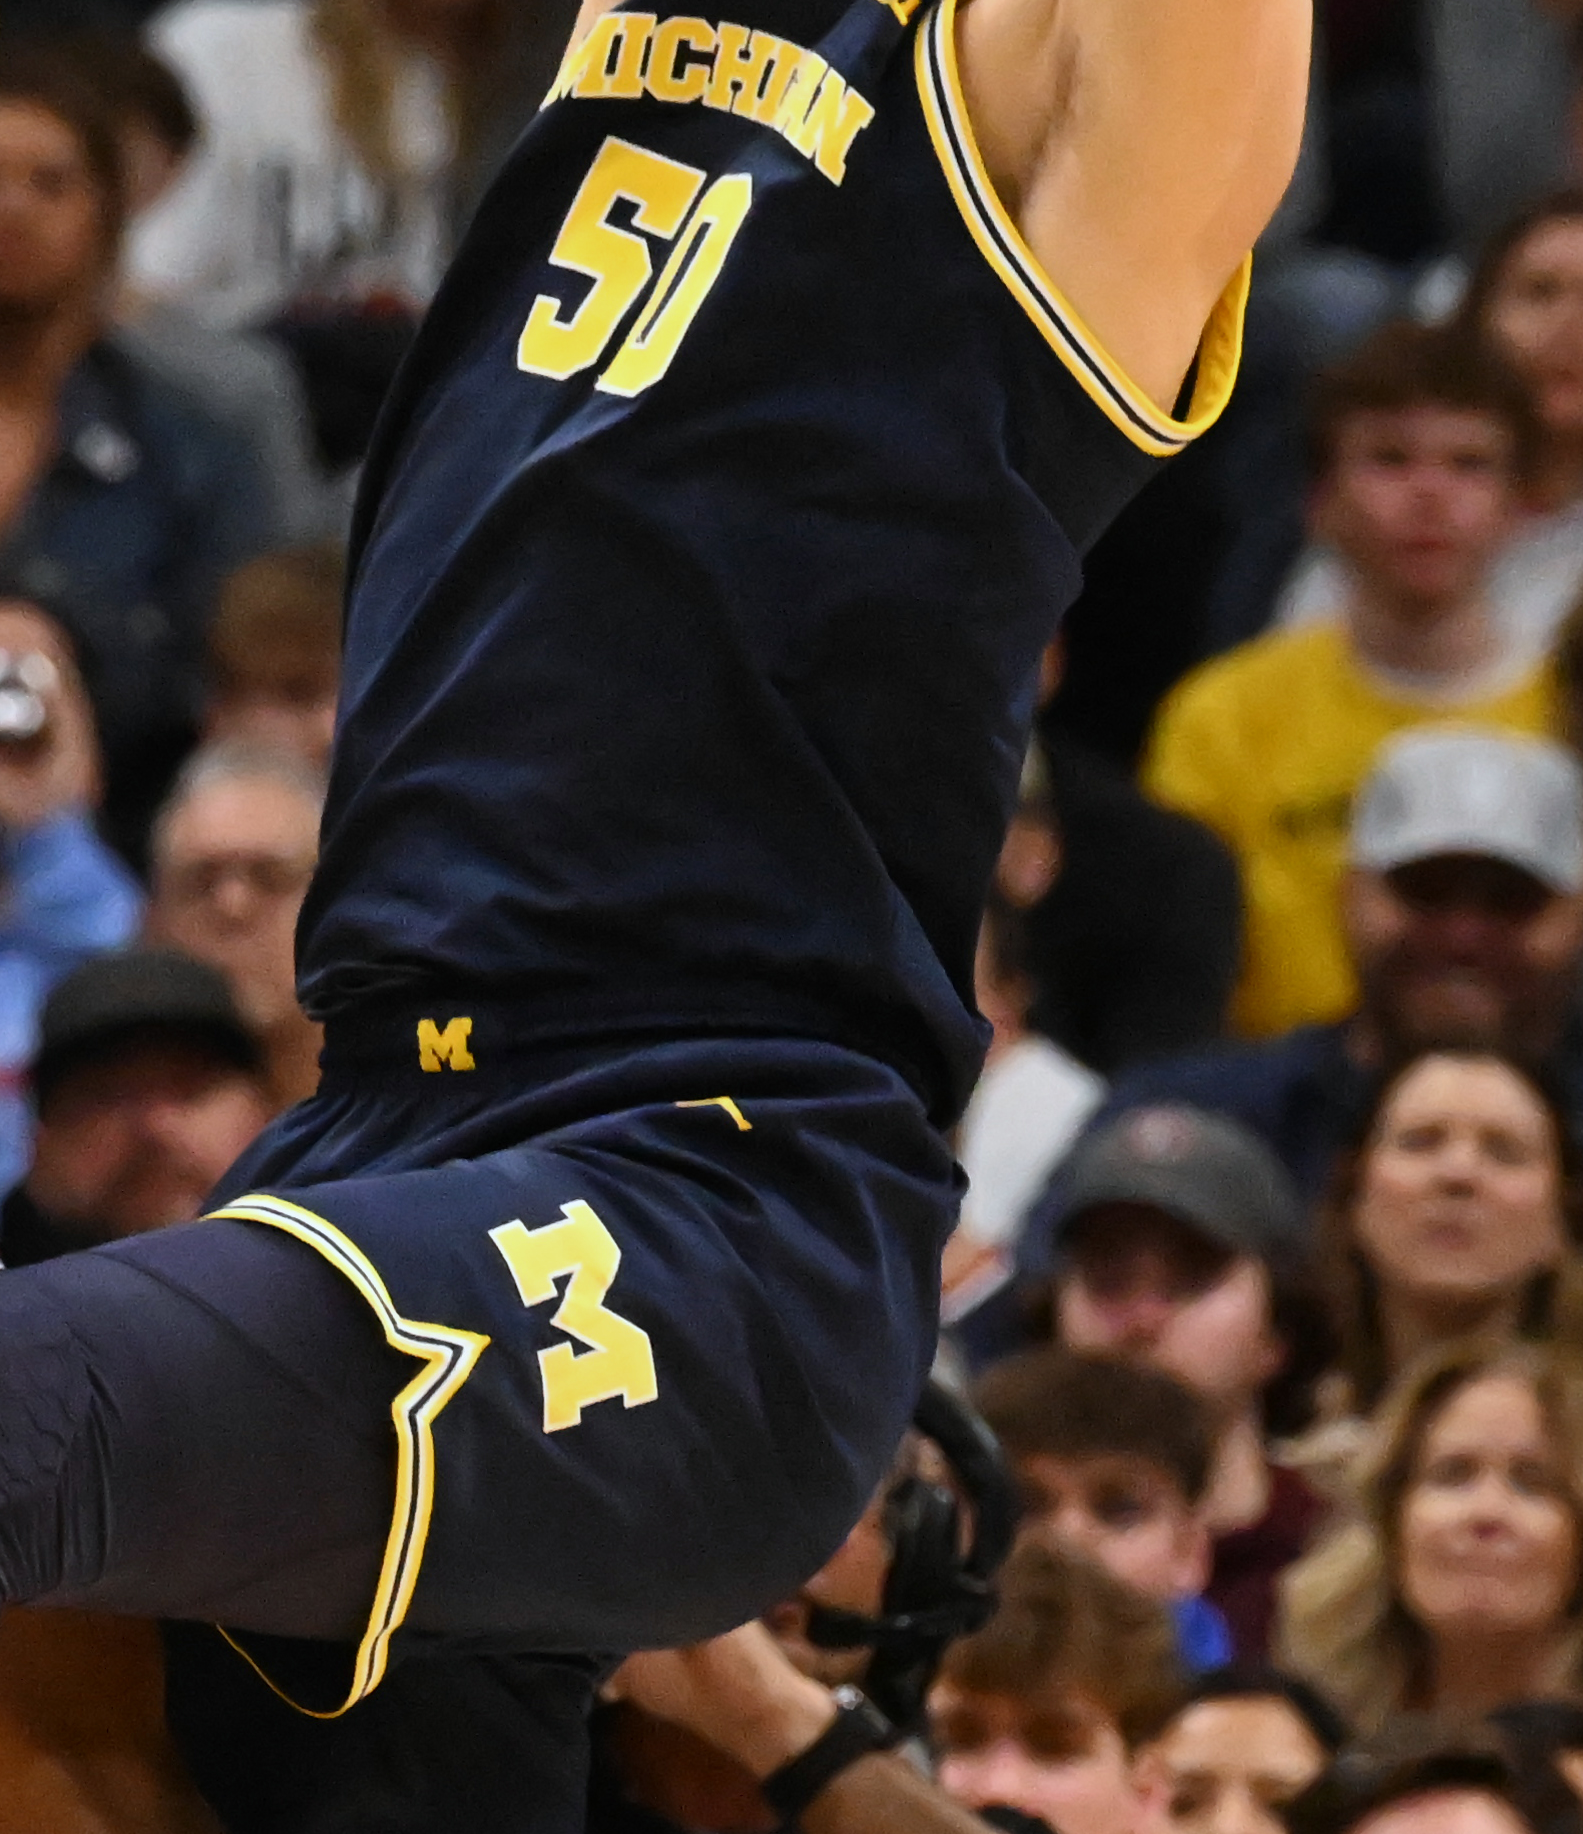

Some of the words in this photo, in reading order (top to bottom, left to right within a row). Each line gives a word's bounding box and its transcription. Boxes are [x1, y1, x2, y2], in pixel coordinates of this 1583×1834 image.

[517, 135, 753, 398] 50
[417, 1016, 476, 1073] M
[488, 1199, 658, 1434] M
